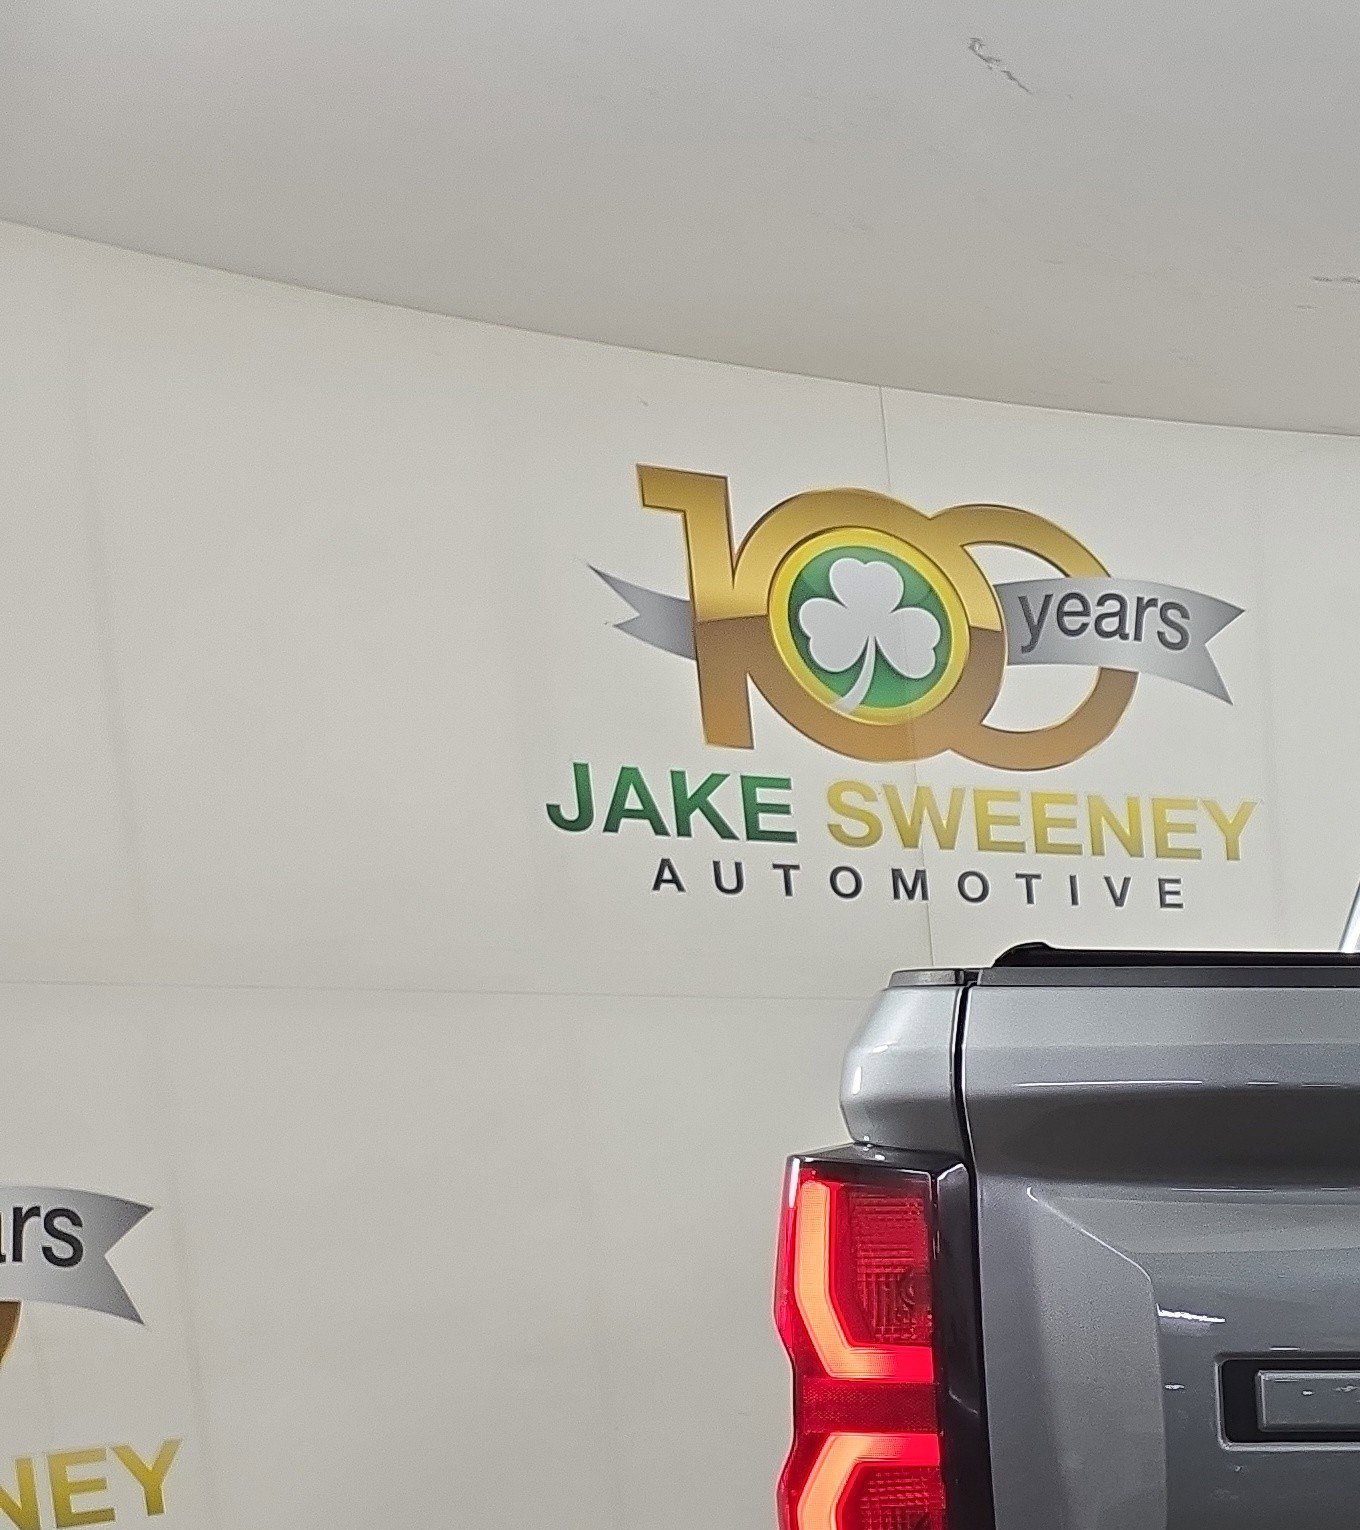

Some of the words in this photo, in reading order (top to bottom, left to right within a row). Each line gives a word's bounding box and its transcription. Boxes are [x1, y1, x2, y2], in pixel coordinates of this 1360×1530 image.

[636, 464, 1139, 771] 100
[1018, 592, 1191, 653] years
[546, 762, 798, 843] JAKE
[826, 780, 1259, 861] SWEENEY
[652, 858, 1184, 909] AUTOMOTIVE
